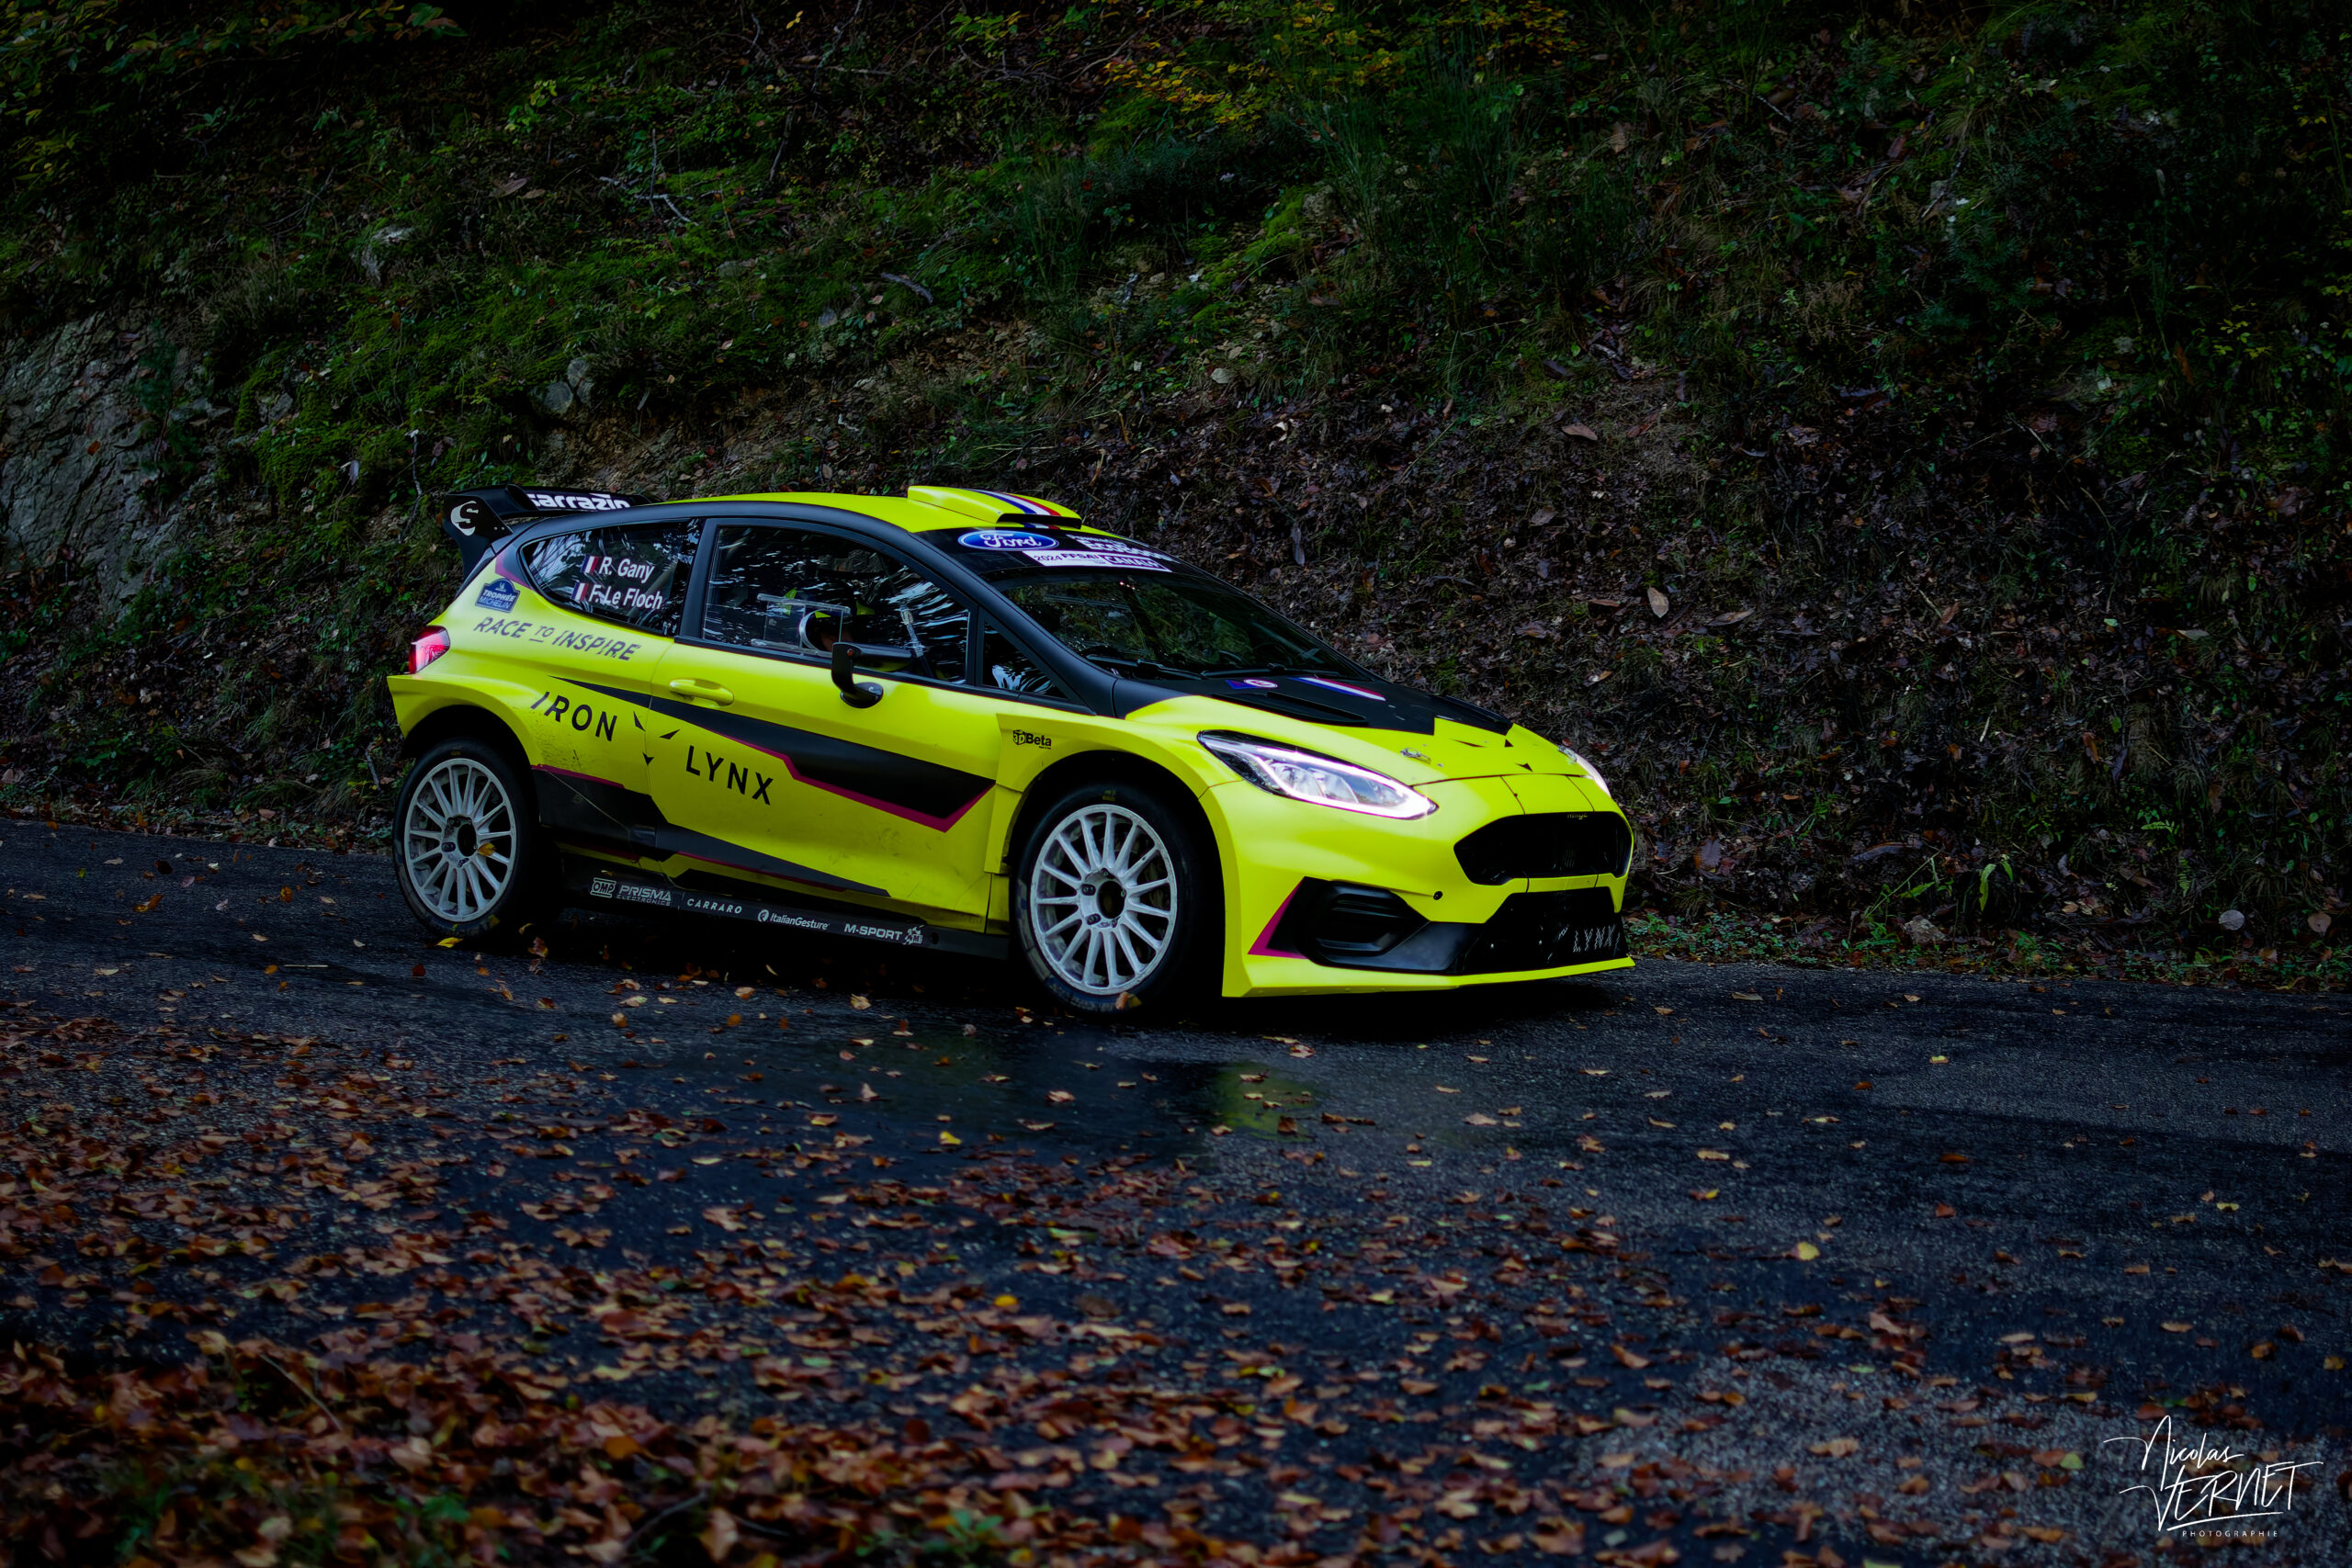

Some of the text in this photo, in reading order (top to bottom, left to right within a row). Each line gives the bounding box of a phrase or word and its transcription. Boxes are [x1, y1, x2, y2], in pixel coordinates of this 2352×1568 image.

[979, 533, 1042, 548] Ford
[598, 556, 655, 583] R. Gany
[482, 589, 517, 602] TROPHÉE
[588, 584, 663, 610] F. Le Floch
[473, 616, 641, 660] RACE TO INSPIRE
[530, 692, 617, 742] IRON
[1026, 733, 1051, 747] Beta
[685, 745, 774, 806] LYNX
[591, 879, 616, 896] OMP
[618, 885, 672, 901] PRISMA
[616, 894, 671, 907] ELECTRONICS
[686, 897, 742, 914] CARRARO
[770, 913, 829, 931] ItalianGesture
[843, 922, 903, 942] M-SPORT
[1572, 925, 1617, 953] LYNX
